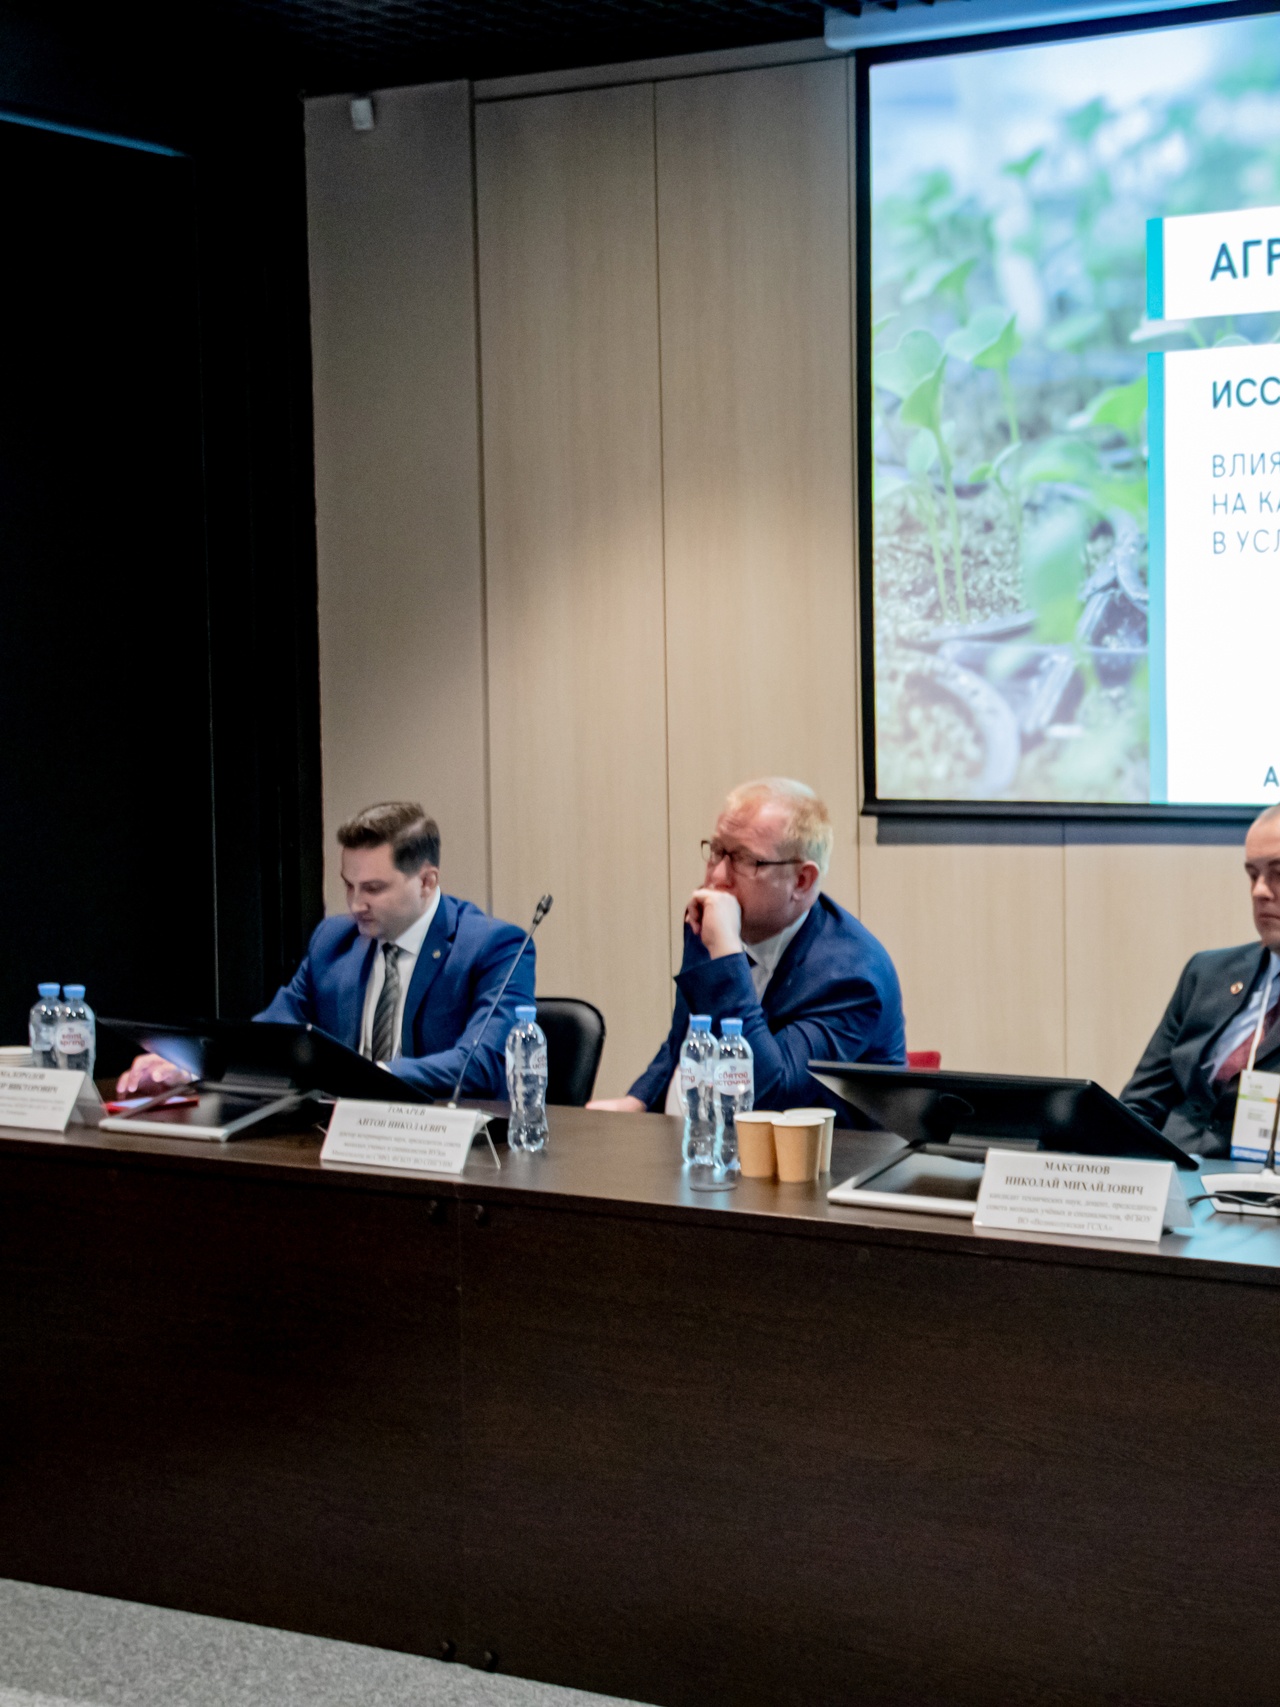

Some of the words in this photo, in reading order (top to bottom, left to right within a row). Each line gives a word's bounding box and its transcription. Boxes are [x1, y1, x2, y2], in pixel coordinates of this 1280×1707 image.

[1212, 491, 1247, 515] НА
[1212, 531, 1227, 554] В
[357, 1118, 387, 1128] АНТОН
[388, 1120, 448, 1133] НИКОЛАЕВИЧ
[1044, 1161, 1110, 1175] МАКСИМОВ
[1004, 1175, 1060, 1189] НИКОЛАЙ
[1062, 1178, 1144, 1195] МИХАЙЛОВИЧ
